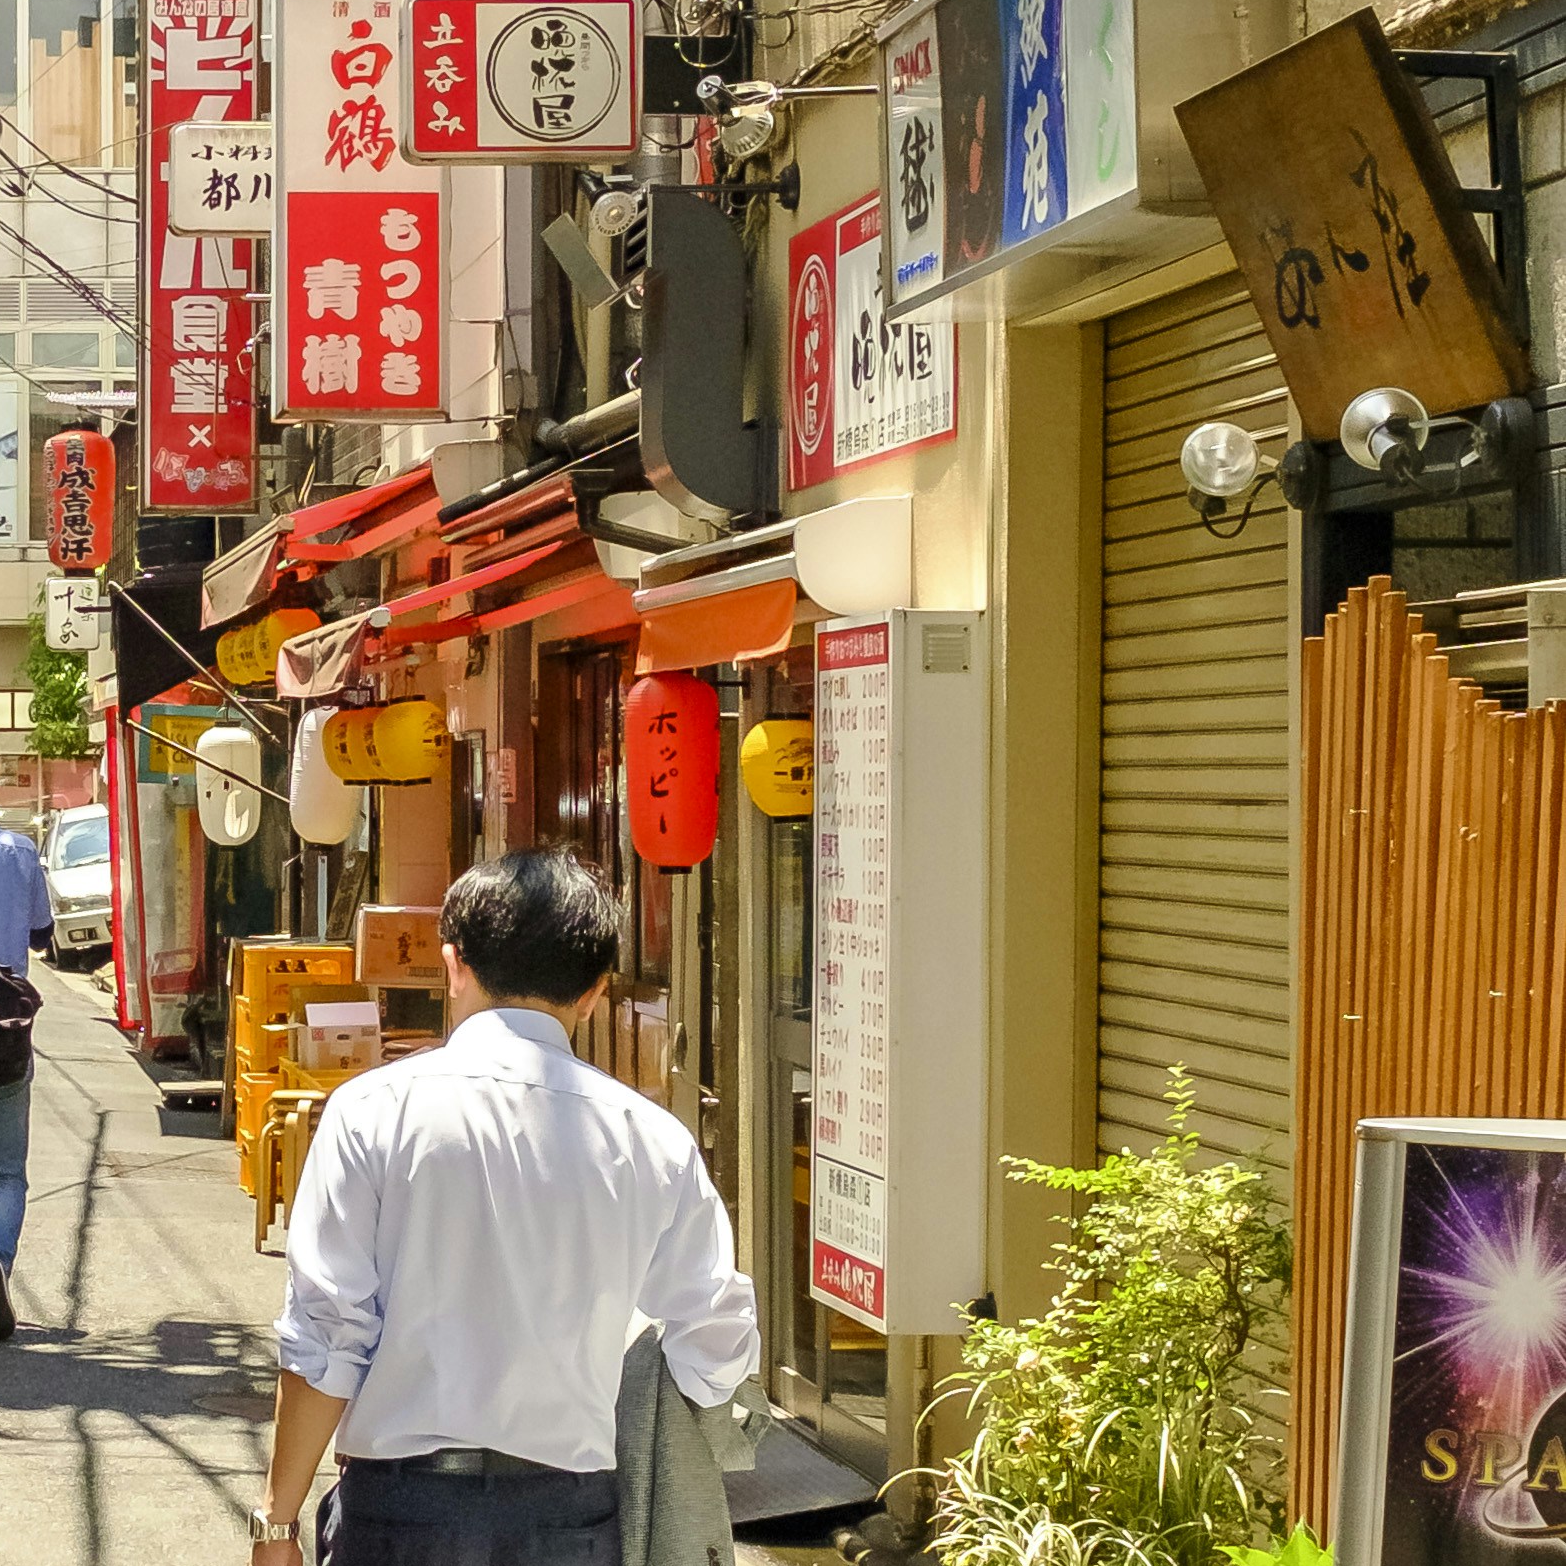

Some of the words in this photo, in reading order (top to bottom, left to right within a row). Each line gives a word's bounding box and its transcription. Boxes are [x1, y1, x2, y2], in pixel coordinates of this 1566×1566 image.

[331, 0, 392, 19] 清酒
[325, 19, 396, 174] 白鶴
[422, 12, 467, 137] 立呑み
[302, 258, 363, 396] 青樹
[379, 208, 424, 396] もつやき
[58, 467, 96, 561] 成吉思汗
[862, 671, 885, 700] 200円
[648, 706, 679, 834] ホッピー
[1420, 1428, 1566, 1491] SPA
